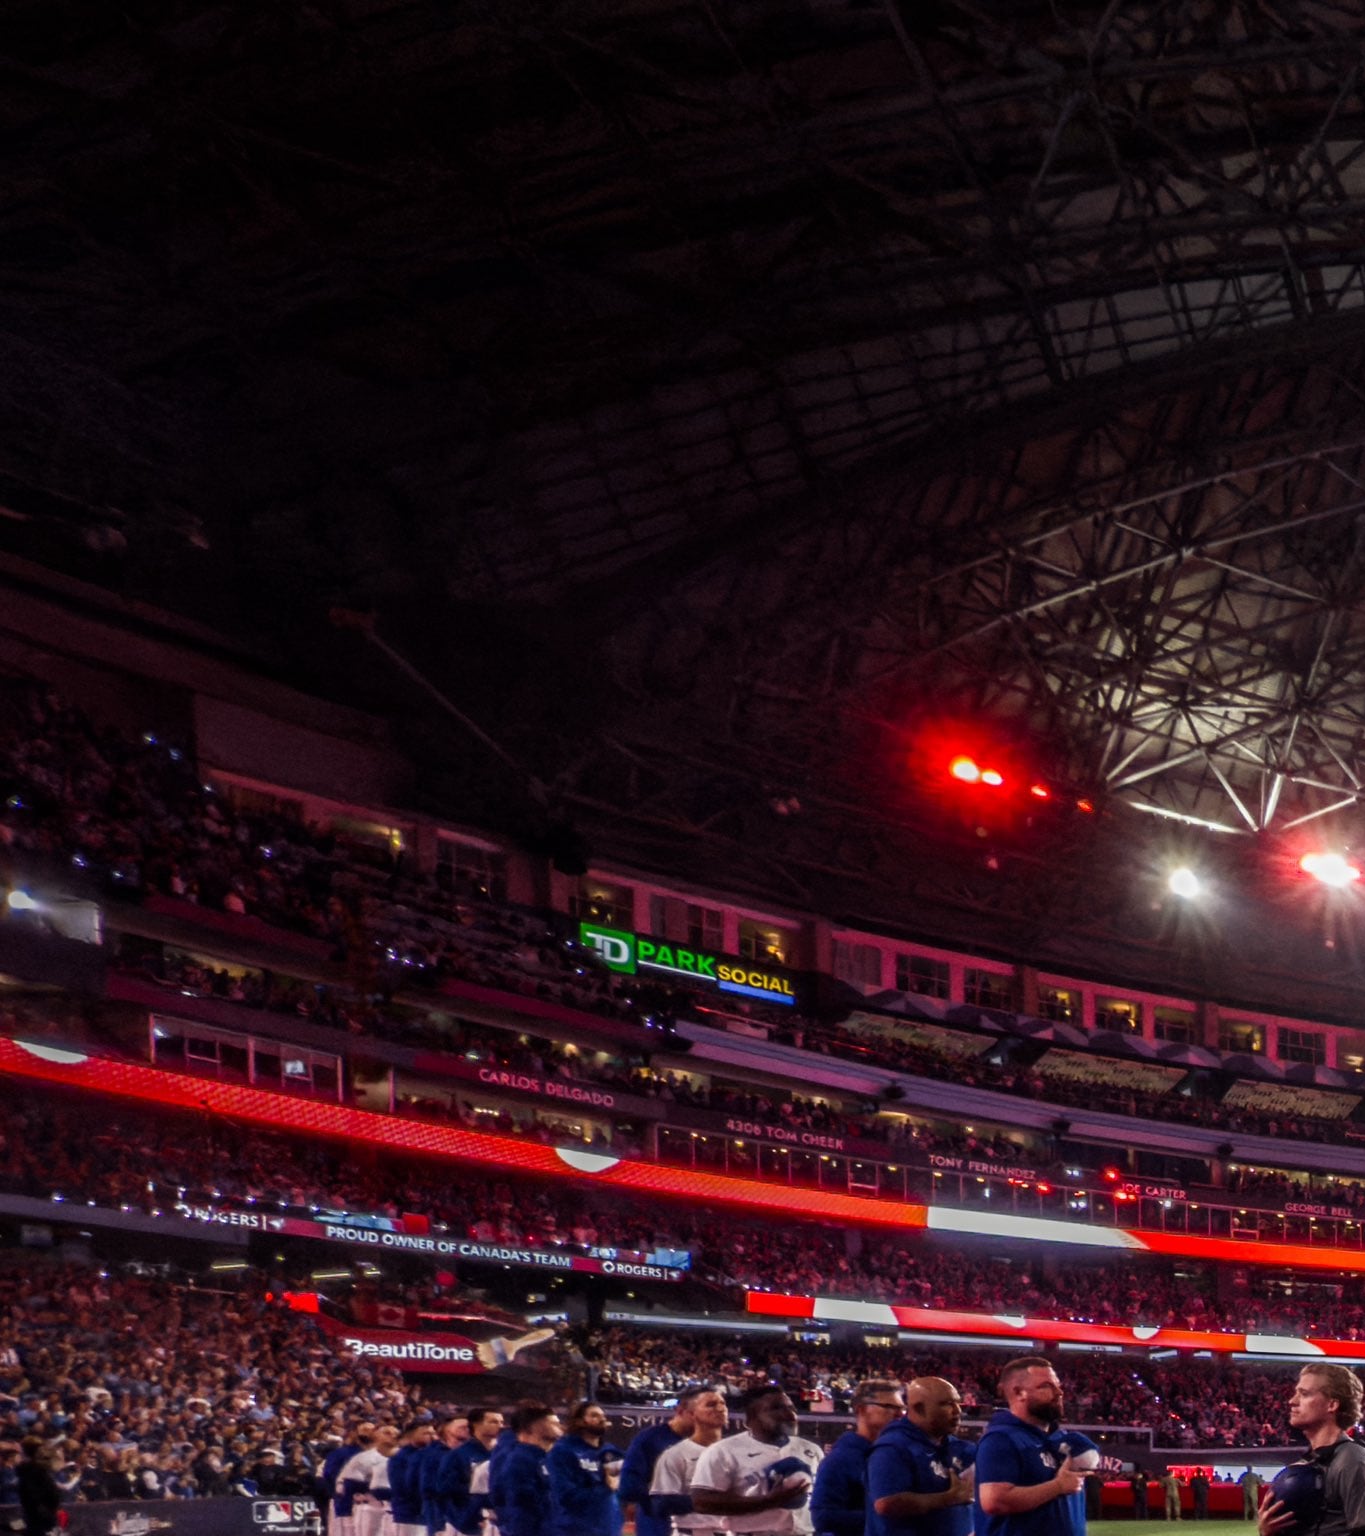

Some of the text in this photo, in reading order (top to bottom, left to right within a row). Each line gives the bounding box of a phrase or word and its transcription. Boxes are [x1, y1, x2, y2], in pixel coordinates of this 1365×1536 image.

[586, 932, 630, 964] TD
[638, 941, 716, 977] PARK
[718, 965, 795, 995] SOCIAL
[479, 1068, 615, 1107] CARLOS DELGADO
[726, 1118, 844, 1150] 4306 TOM CHEEK
[929, 1154, 1036, 1180] TONY FERNANDEZ
[1121, 1183, 1187, 1200] JOE CARTER
[1284, 1202, 1353, 1218] GEORGE BELL
[326, 1225, 570, 1268] PROUD OWNER OF CANADA'S TEAM
[617, 1263, 662, 1278] ROGERS
[344, 1338, 474, 1361] BeautiTone
